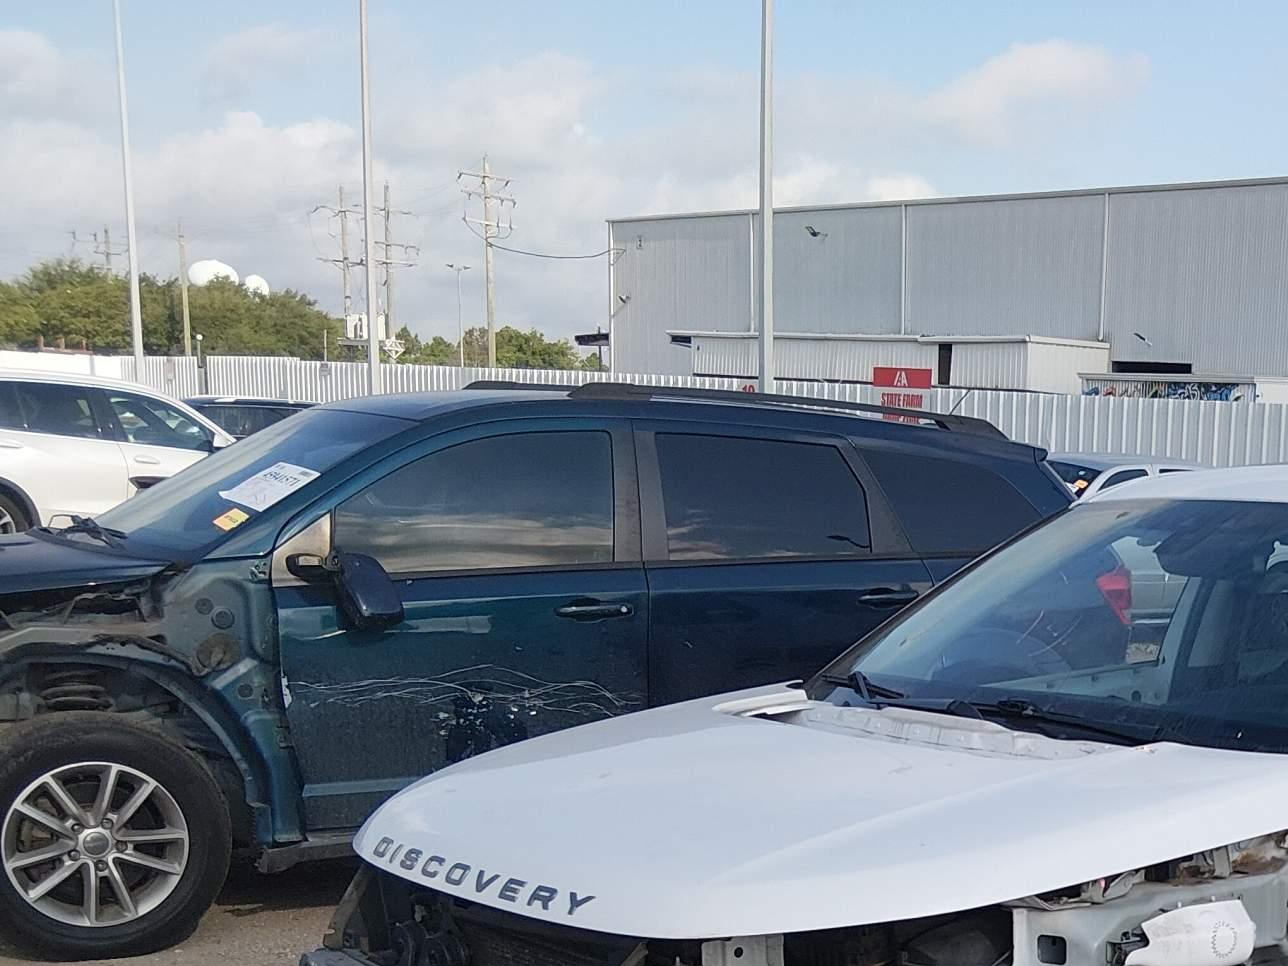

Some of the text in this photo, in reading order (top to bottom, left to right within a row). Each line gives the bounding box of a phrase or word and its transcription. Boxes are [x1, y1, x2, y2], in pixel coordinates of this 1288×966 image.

[881, 392, 923, 409] STATE FARM
[372, 836, 597, 916] DISCOVERY
